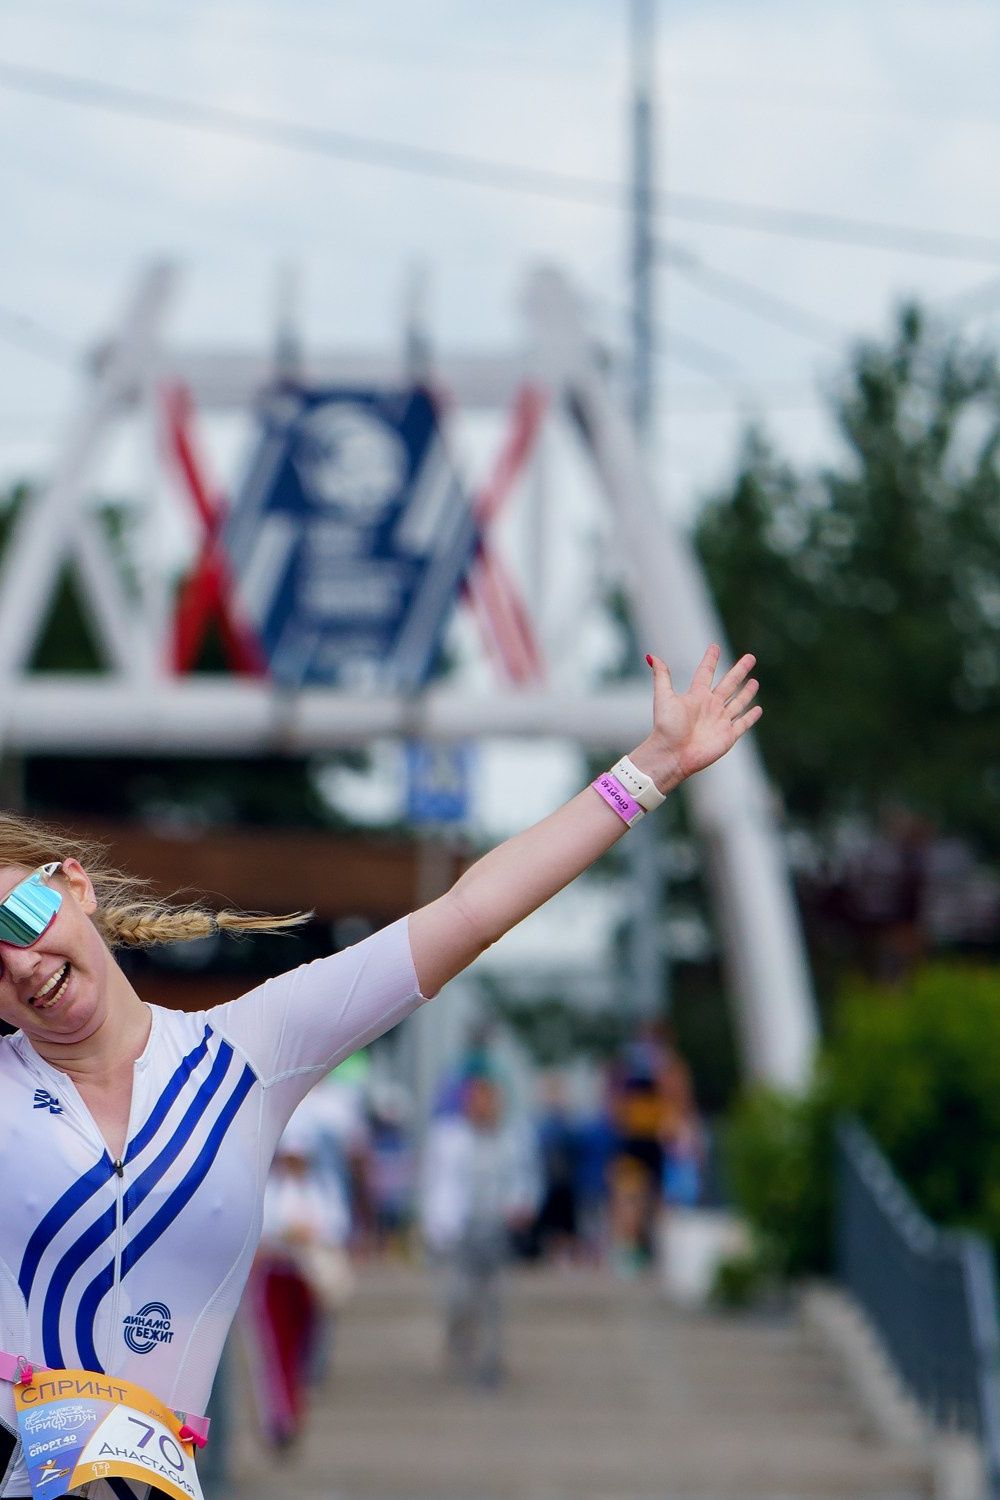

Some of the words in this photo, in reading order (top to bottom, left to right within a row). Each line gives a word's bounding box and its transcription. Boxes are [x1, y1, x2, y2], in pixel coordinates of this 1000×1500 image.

[606, 787, 629, 810] СПОРТ
[122, 1315, 172, 1330] ДИНАМО
[135, 1326, 175, 1344] БЕЖИТ
[20, 1379, 128, 1404] СПРИНТ
[29, 1438, 62, 1457] СПОРТ
[62, 1434, 77, 1443] 40
[127, 1416, 185, 1472] 70
[98, 1441, 196, 1497] АНАСТАСИЯ
